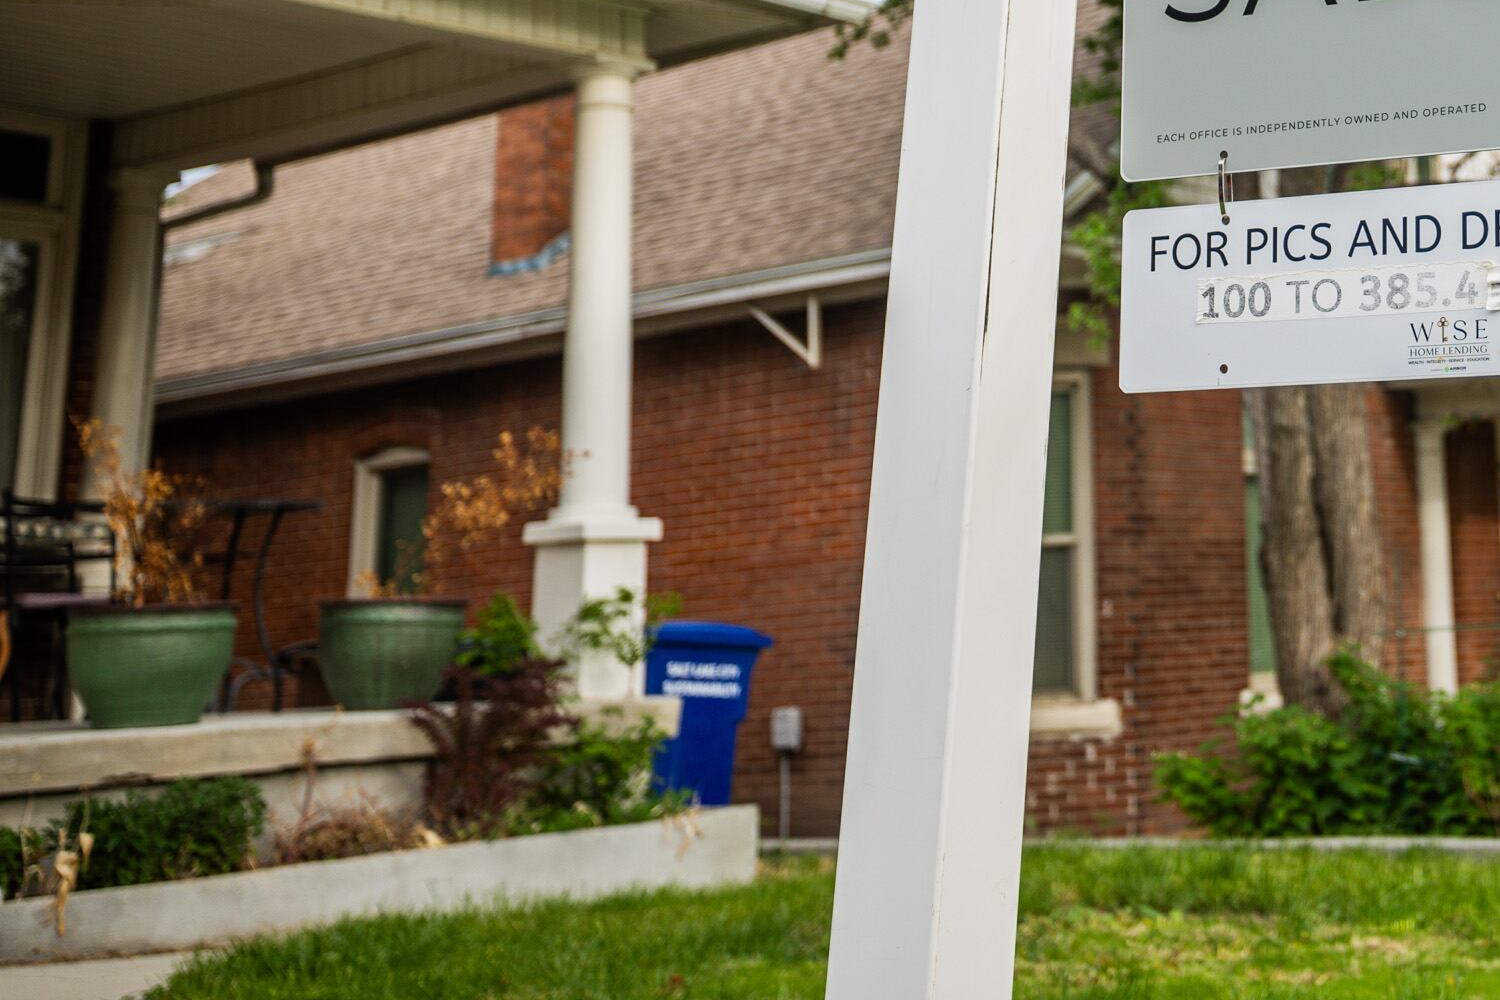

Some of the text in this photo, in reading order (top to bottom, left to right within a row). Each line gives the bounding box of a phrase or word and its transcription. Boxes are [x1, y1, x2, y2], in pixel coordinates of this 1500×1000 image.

[1156, 102, 1487, 144] EACH OFFICE IS INDEPENDENTLY OWNED AND OPERATED
[1150, 231, 1229, 272] FOR
[1246, 222, 1332, 265] PICS
[1348, 214, 1442, 258] AND
[1201, 281, 1272, 319] 100
[1286, 278, 1343, 314] TO
[1409, 344, 1488, 357] HOME LENDING
